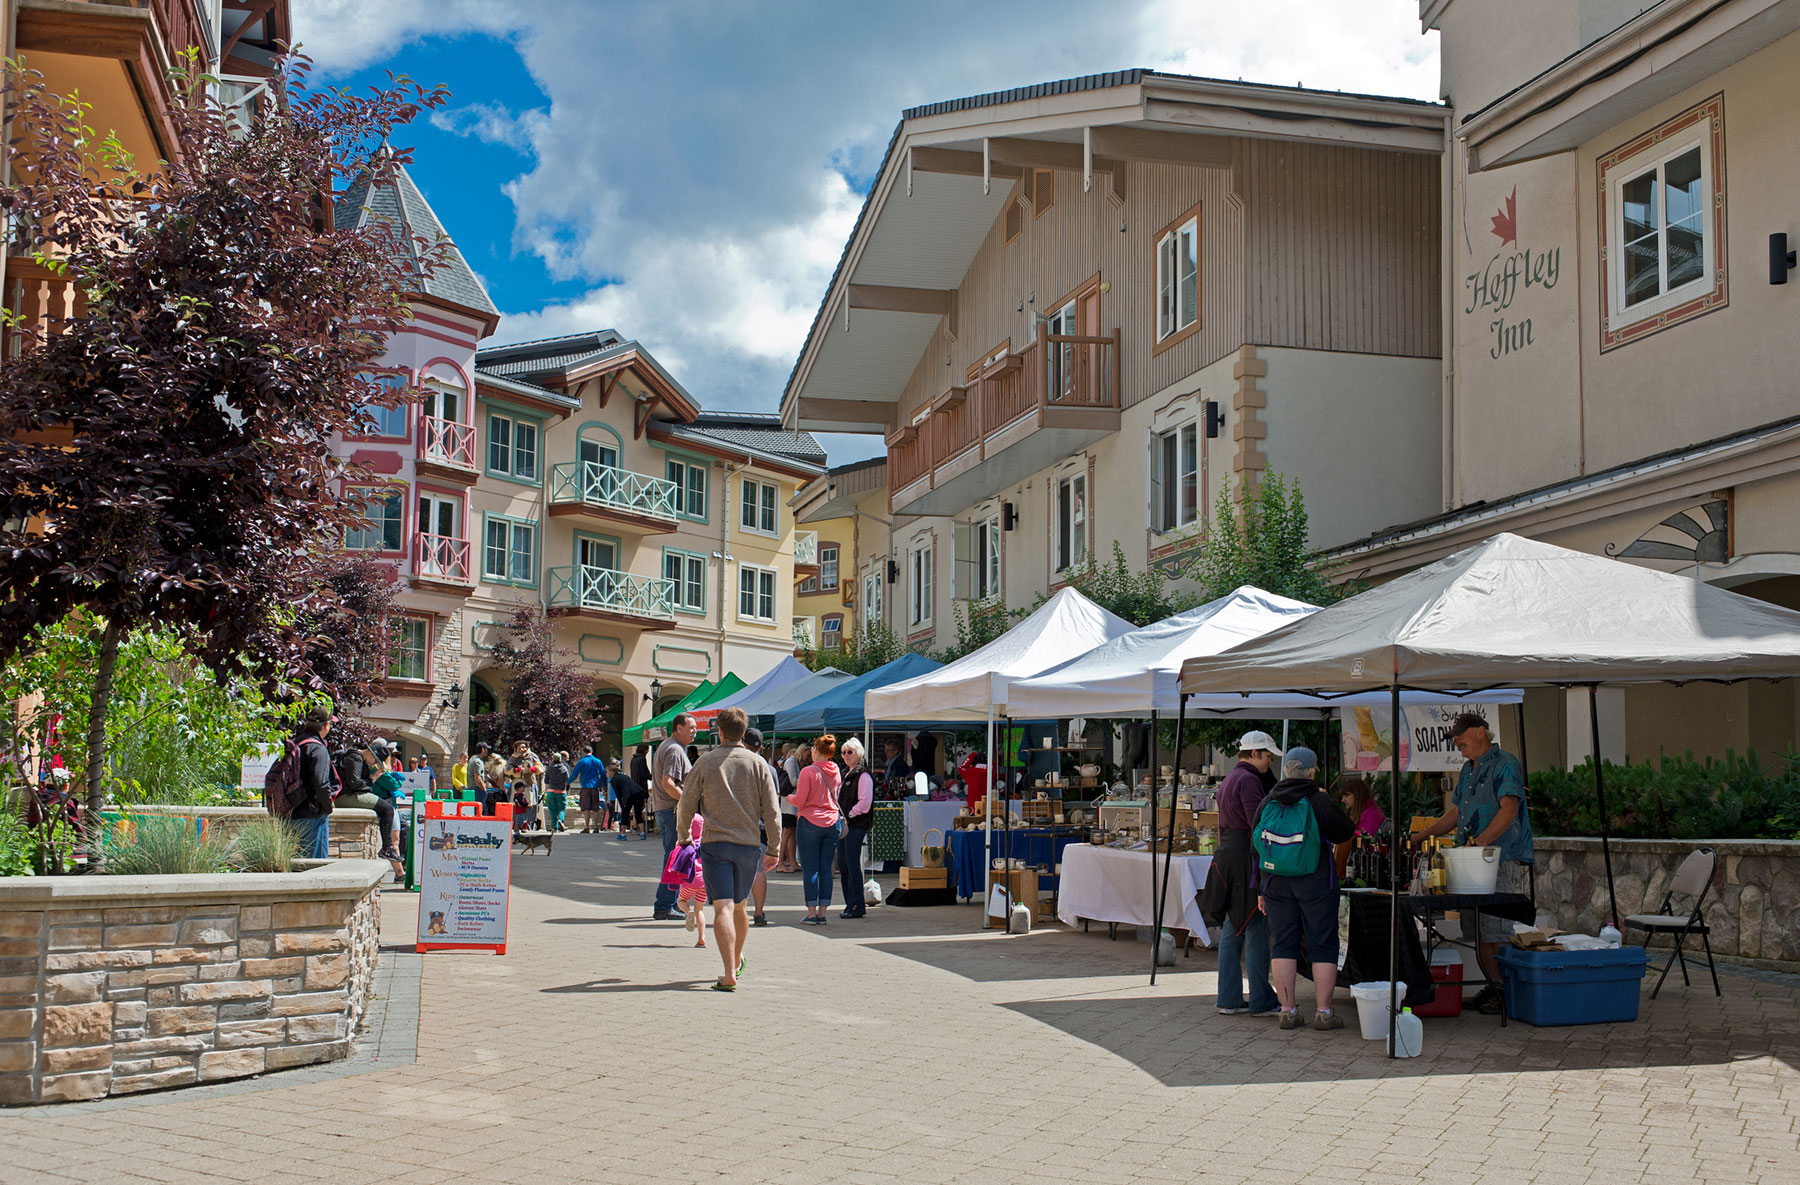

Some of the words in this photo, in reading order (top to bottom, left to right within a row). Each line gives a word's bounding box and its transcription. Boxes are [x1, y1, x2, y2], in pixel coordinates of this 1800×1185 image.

[1465, 246, 1560, 314] Heffley
[1490, 317, 1536, 361] Inn
[1415, 726, 1462, 752] SOAPW
[457, 833, 504, 849] Sneaky
[431, 869, 458, 878] WOMEN
